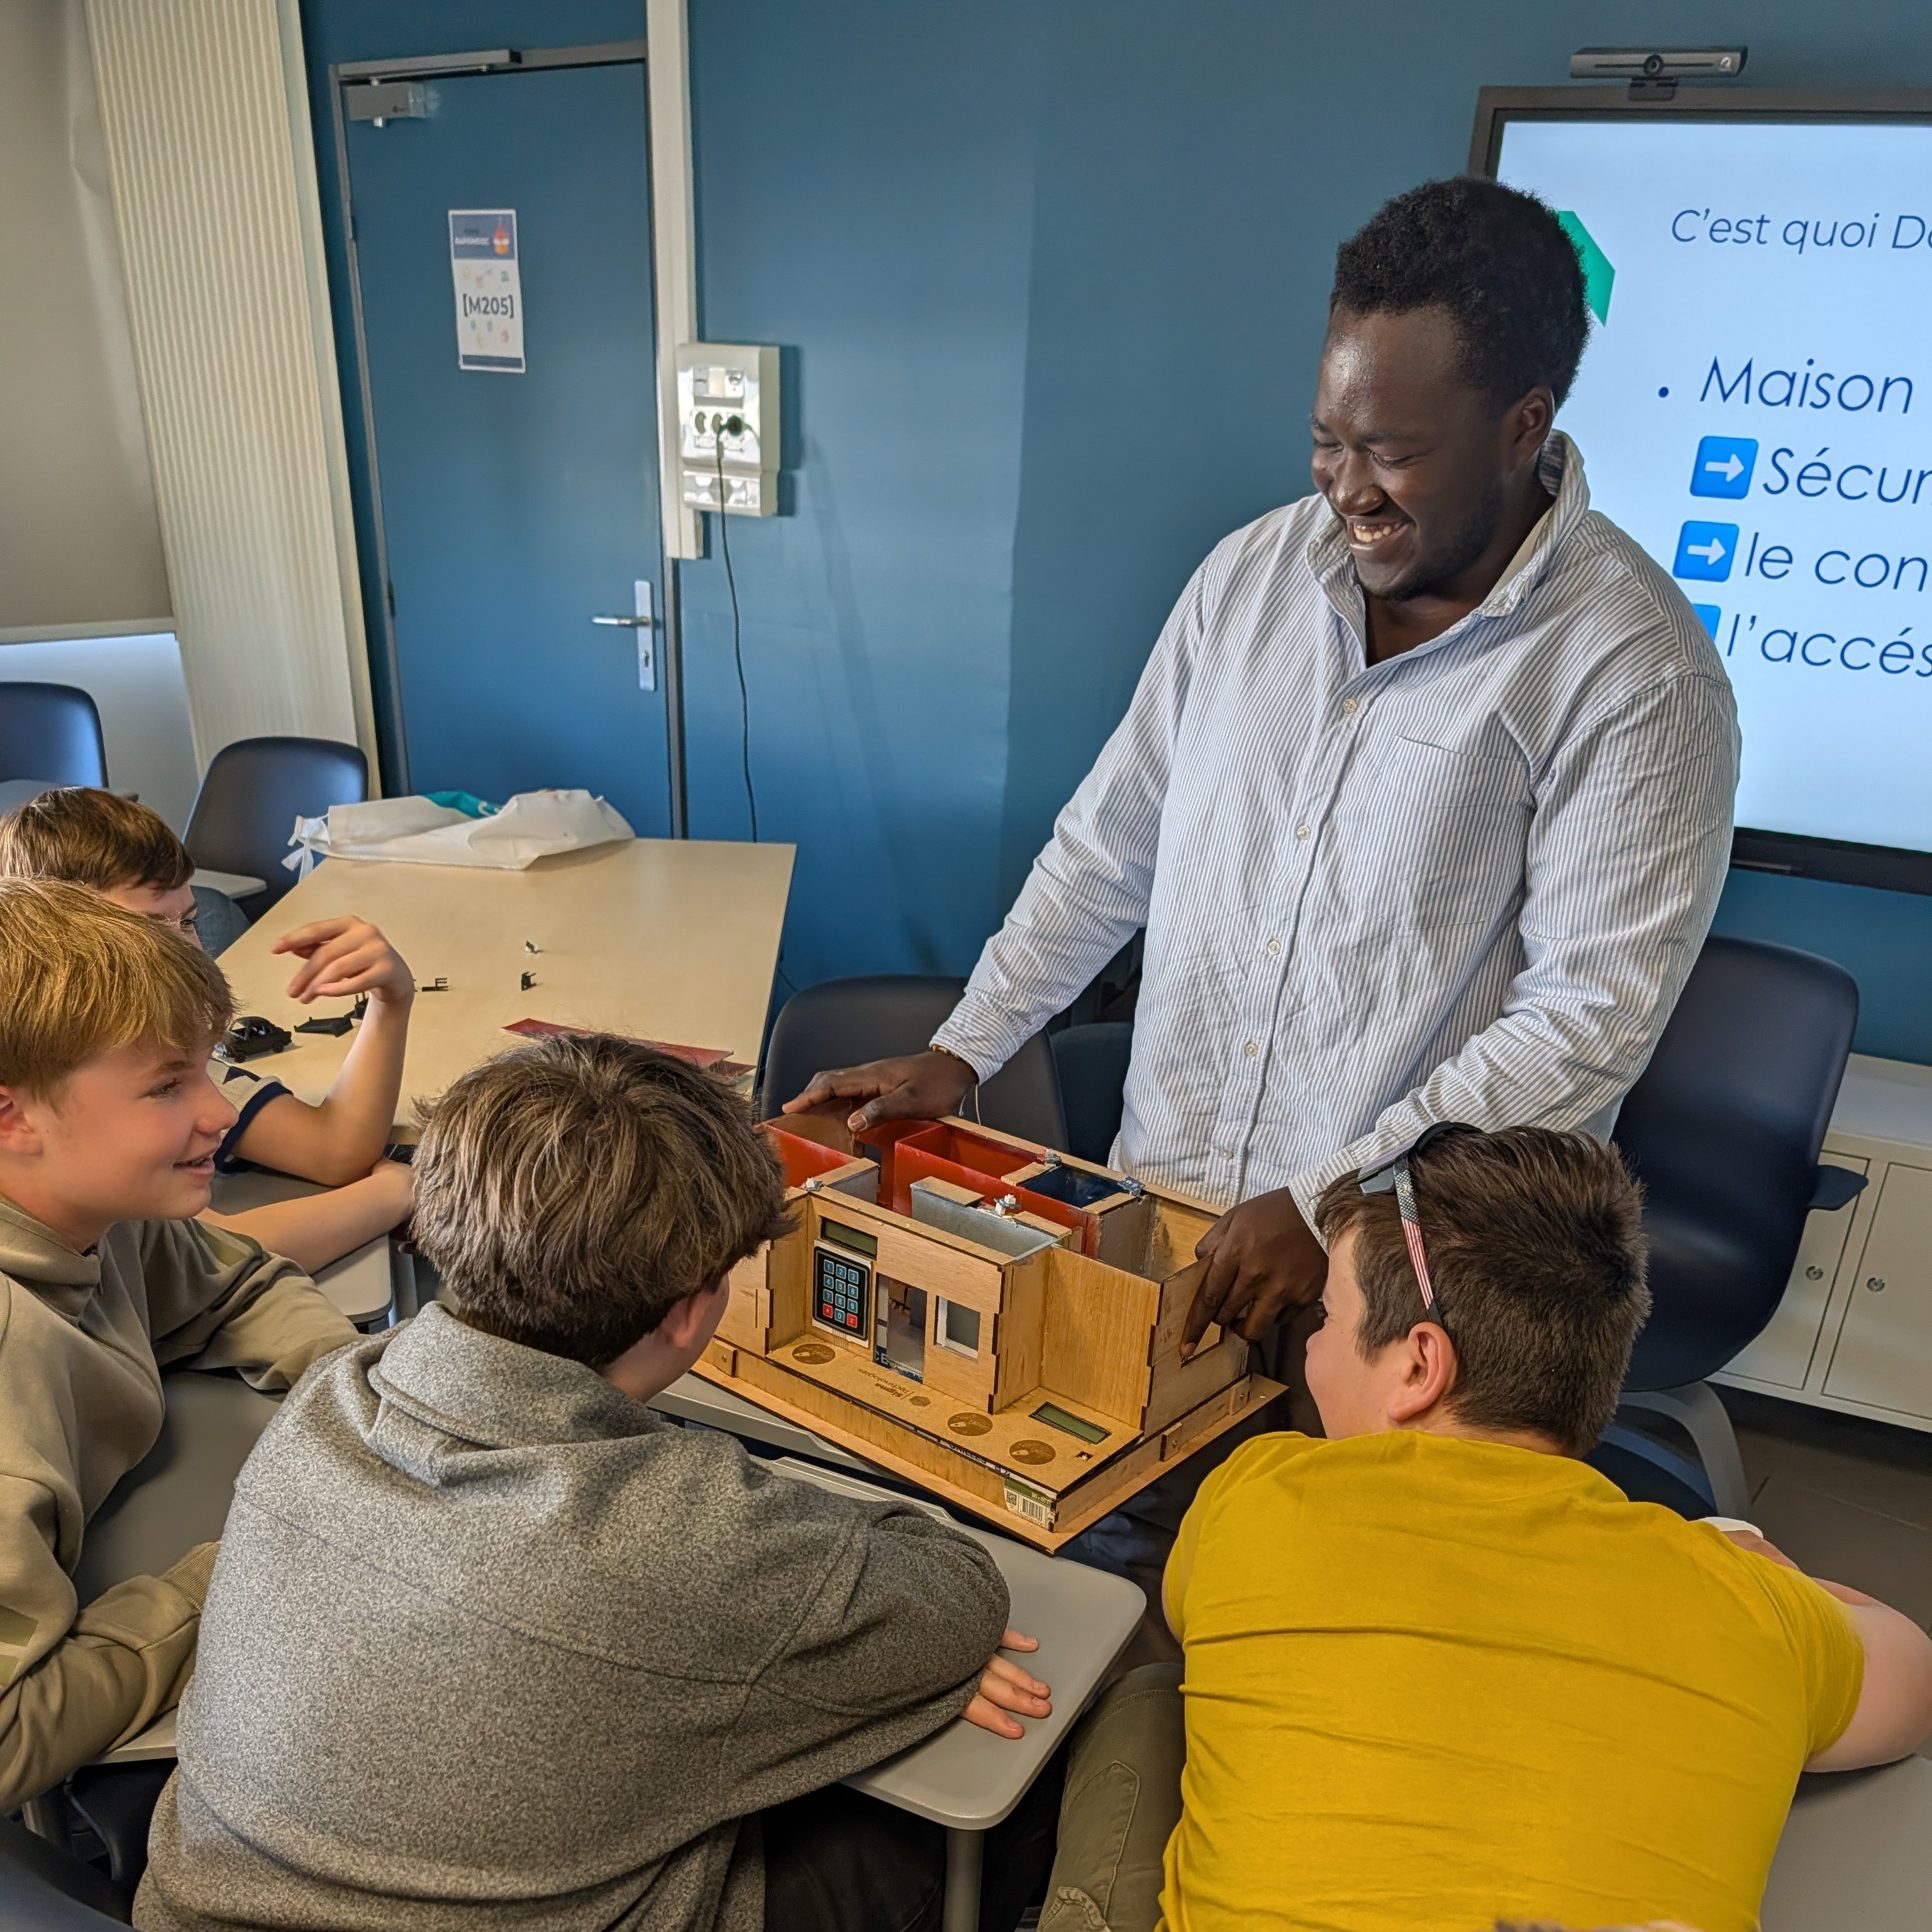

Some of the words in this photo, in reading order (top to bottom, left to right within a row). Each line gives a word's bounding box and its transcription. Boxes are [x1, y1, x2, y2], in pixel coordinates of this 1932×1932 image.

[1671, 209, 1770, 246] C'est
[1782, 212, 1880, 255] quoi
[1699, 357, 1913, 414] Maison
[1745, 532, 1794, 580] le
[1814, 550, 1928, 593] con
[857, 1368, 910, 1394] Technologies
